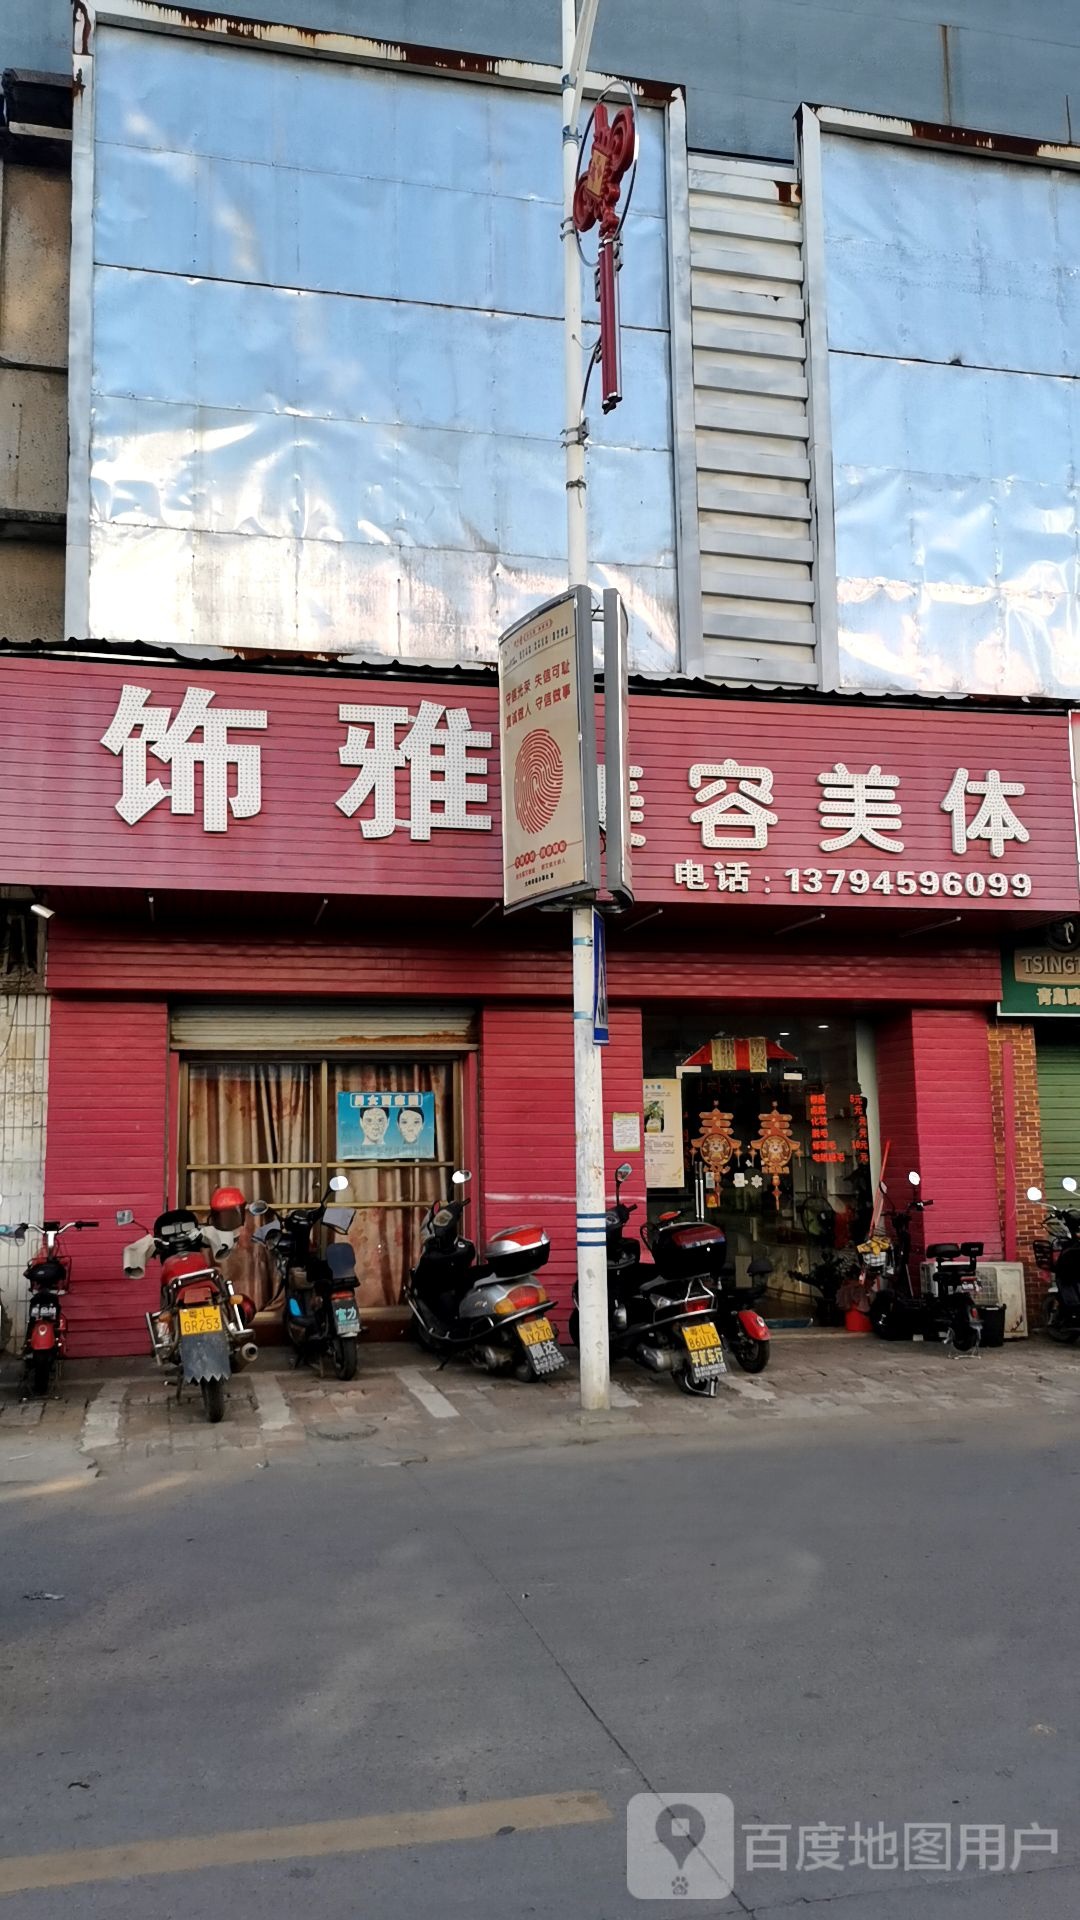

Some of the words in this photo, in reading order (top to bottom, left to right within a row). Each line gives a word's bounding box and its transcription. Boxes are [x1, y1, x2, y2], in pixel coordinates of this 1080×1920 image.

[534, 659, 570, 688] 失信可耻
[535, 683, 571, 711] 守信做事
[100, 685, 492, 841] 饰雅
[597, 759, 1030, 858] 容美体
[184, 1317, 220, 1333] GR253
